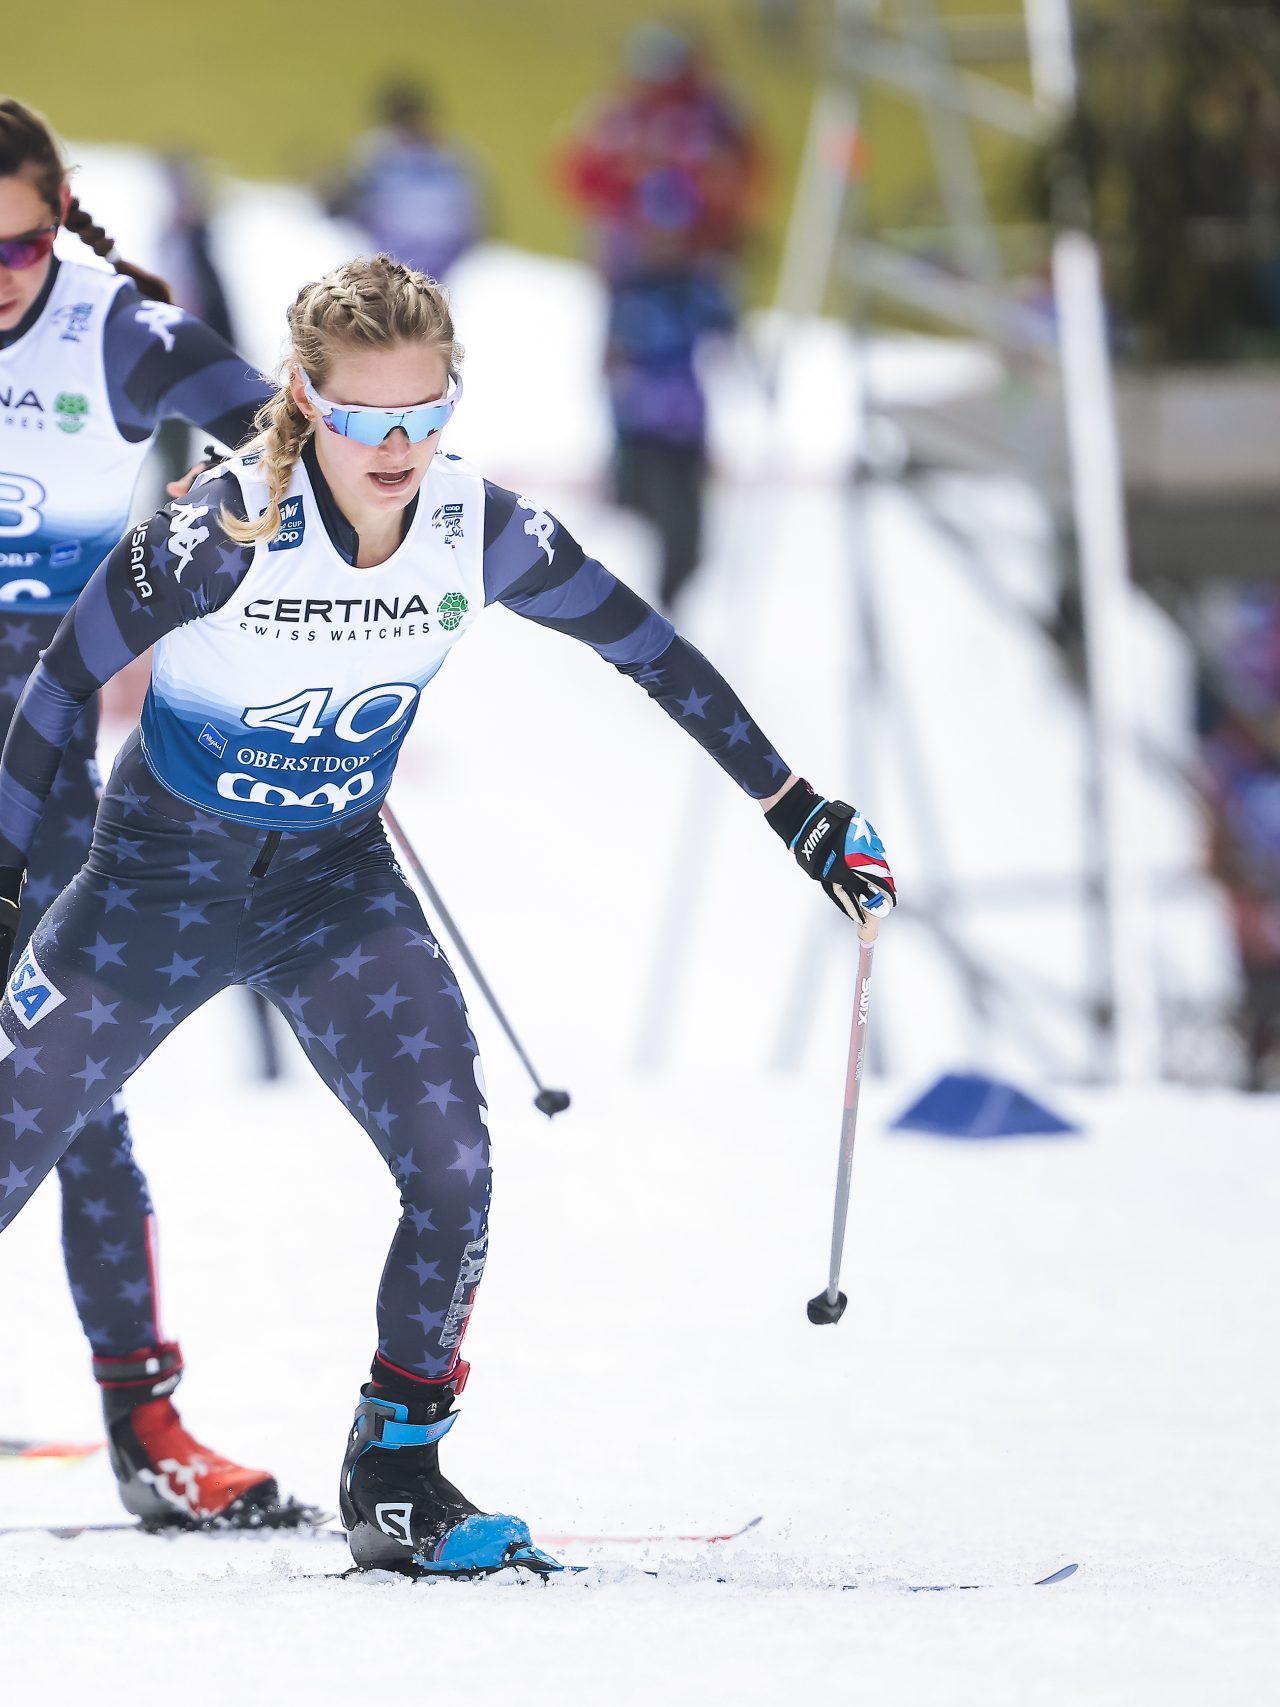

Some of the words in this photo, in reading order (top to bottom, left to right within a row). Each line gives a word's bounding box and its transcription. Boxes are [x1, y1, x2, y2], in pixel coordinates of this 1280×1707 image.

[131, 517, 153, 599] USANA
[244, 594, 429, 623] CERTINA
[239, 622, 316, 641] SWISS
[330, 622, 430, 641] WATCHES
[240, 681, 421, 744] 40
[236, 748, 383, 773] OBERSTDOR
[217, 770, 374, 813] coop
